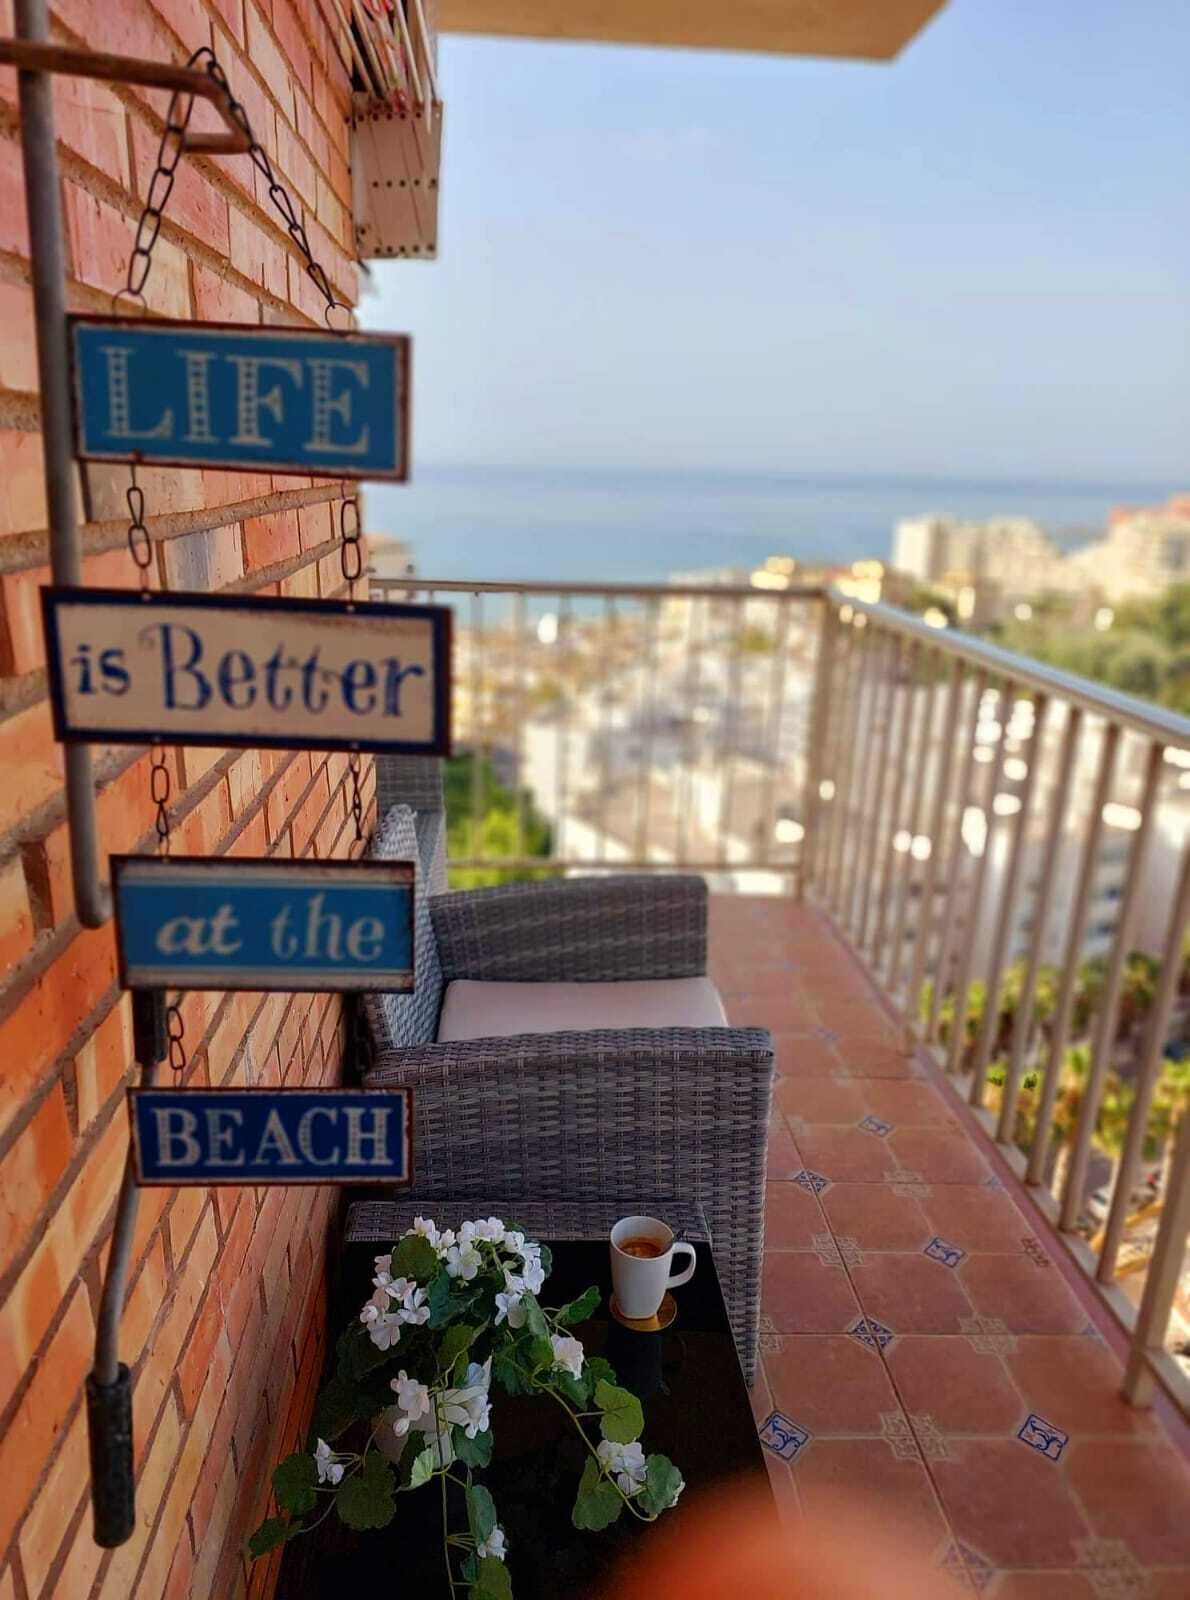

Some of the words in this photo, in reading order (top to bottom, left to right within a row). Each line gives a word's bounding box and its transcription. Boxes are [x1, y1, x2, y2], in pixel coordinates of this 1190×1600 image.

[98, 345, 370, 455] LIFE
[71, 644, 130, 696] is
[139, 622, 425, 717] Better
[156, 903, 243, 956] at
[271, 892, 385, 961] the
[151, 1106, 393, 1168] BEACH
